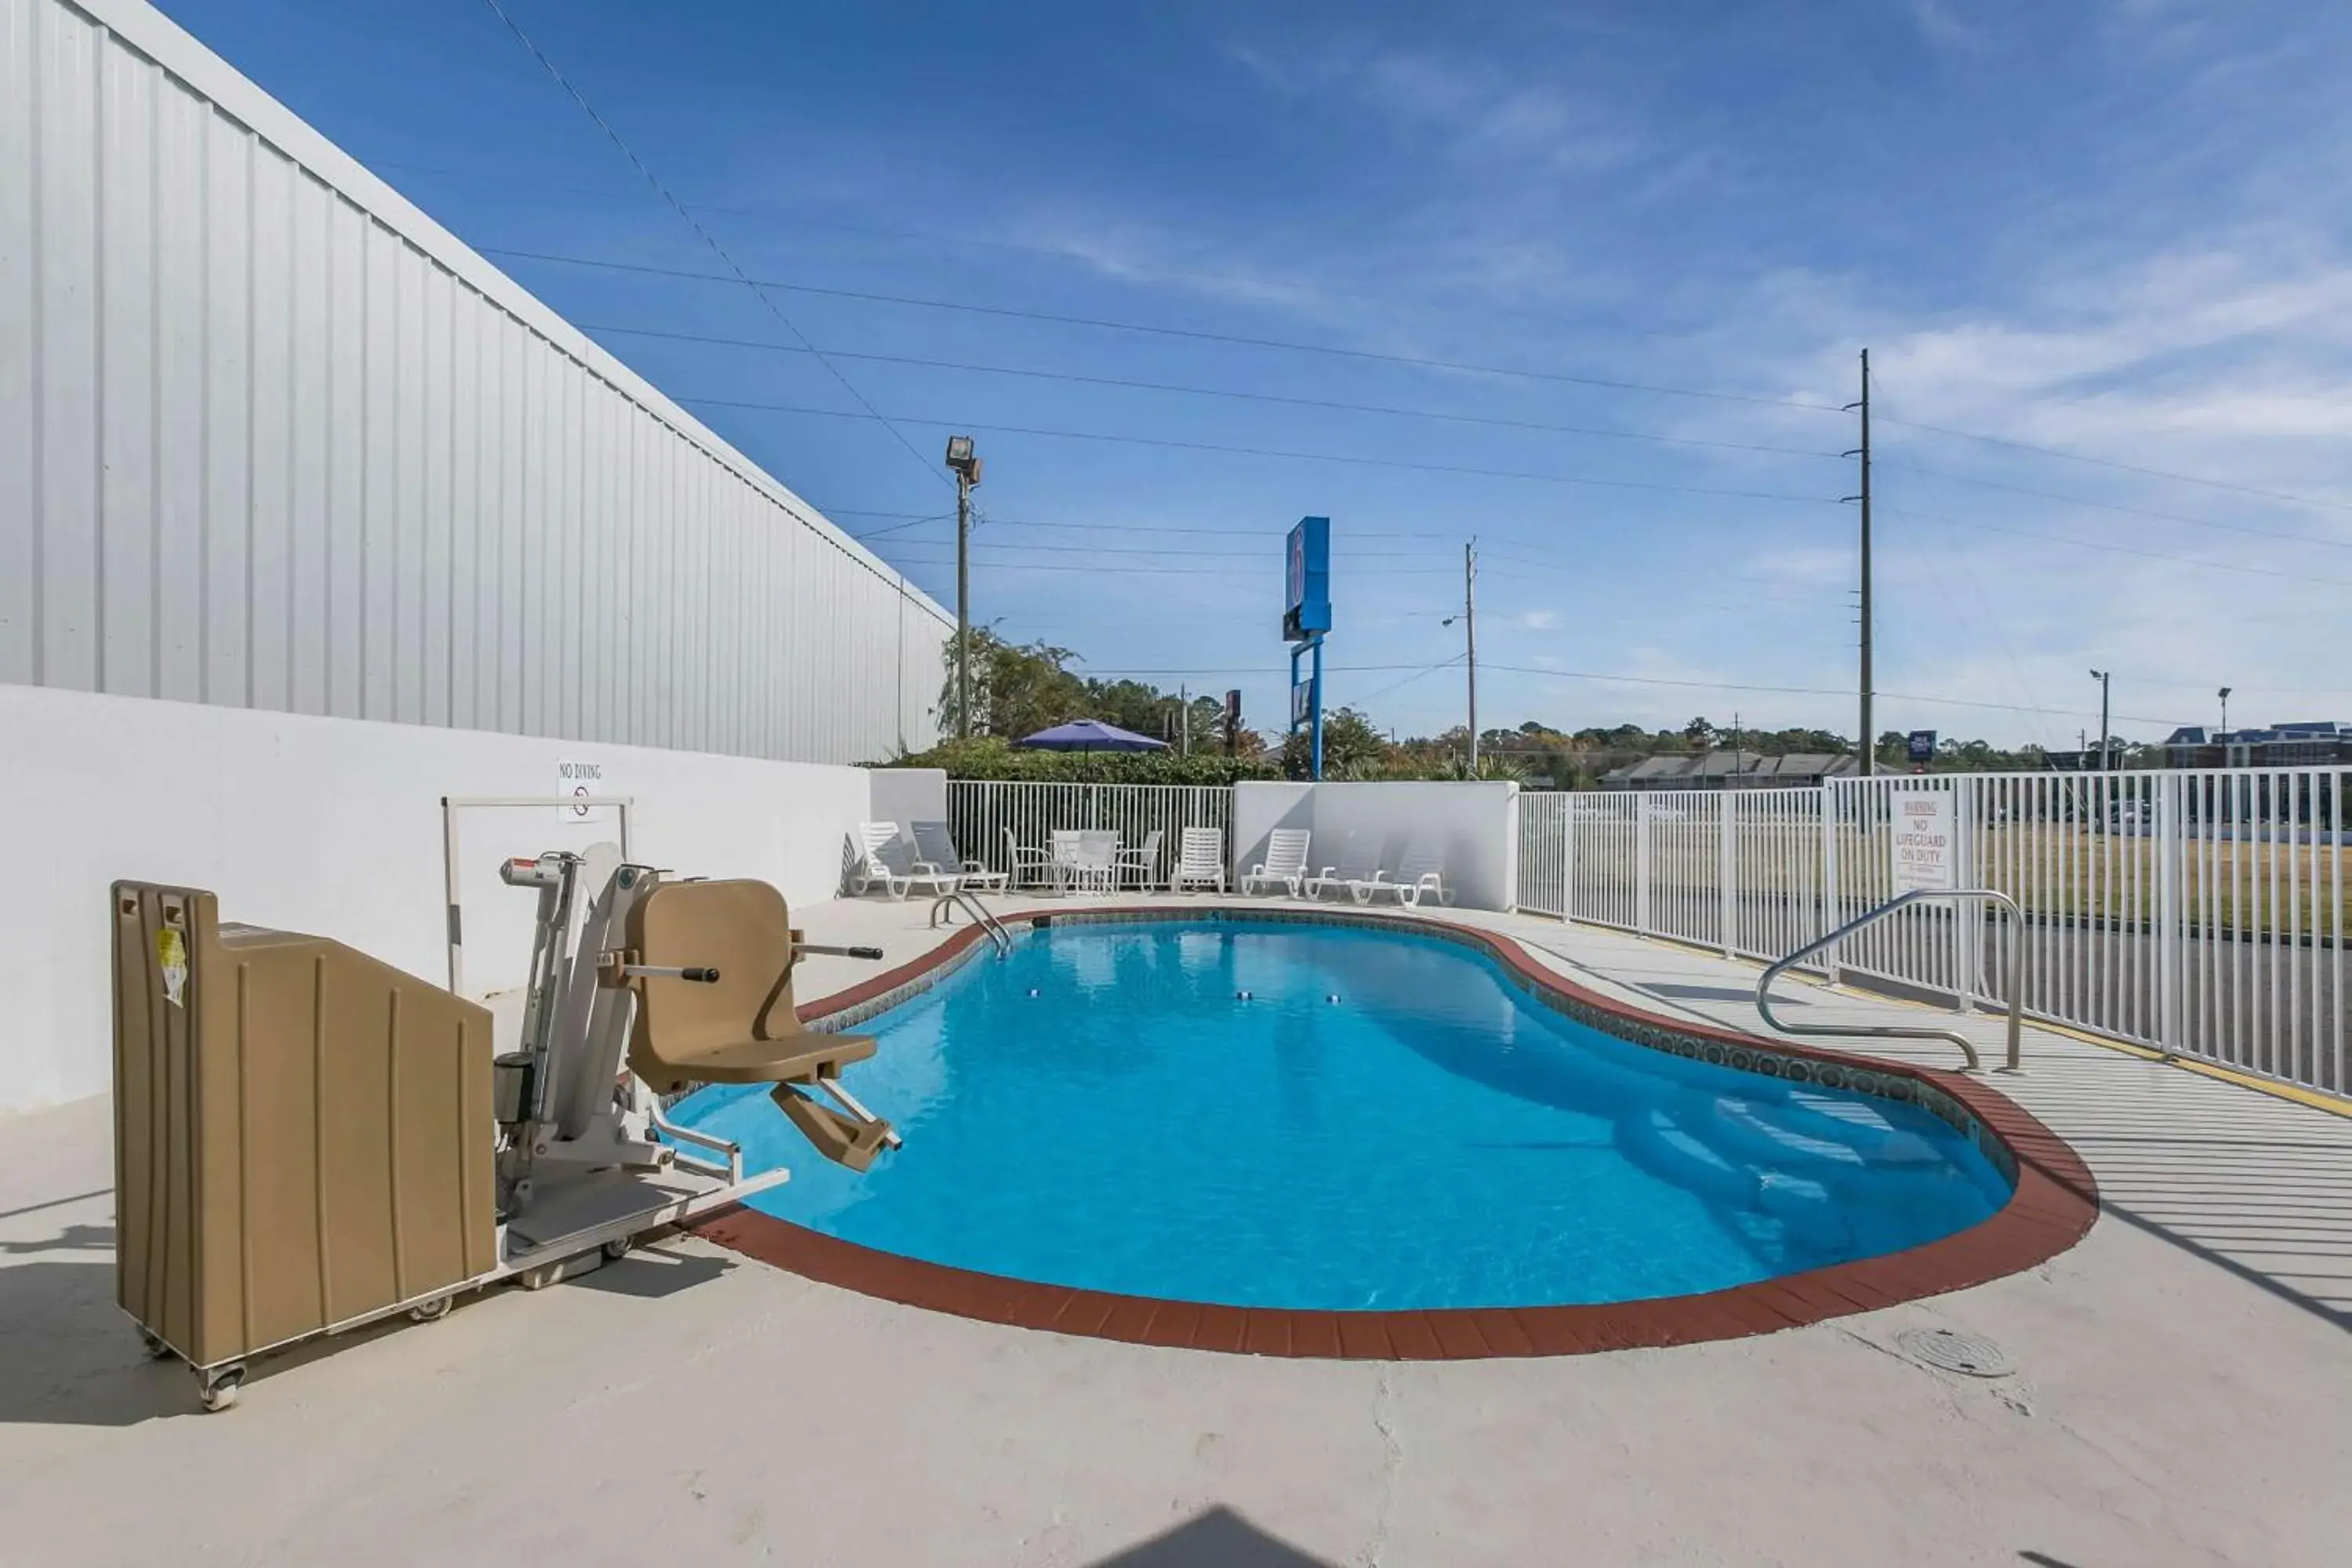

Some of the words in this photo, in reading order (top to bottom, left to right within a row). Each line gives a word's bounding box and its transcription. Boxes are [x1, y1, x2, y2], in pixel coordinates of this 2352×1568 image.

[559, 763, 572, 779] NO
[575, 763, 601, 779] DIVING
[1913, 818, 1928, 832] NO
[1896, 833, 1947, 848] LIFEGUARD
[1901, 848, 1915, 861] ON
[1916, 849, 1941, 863] DUTY
